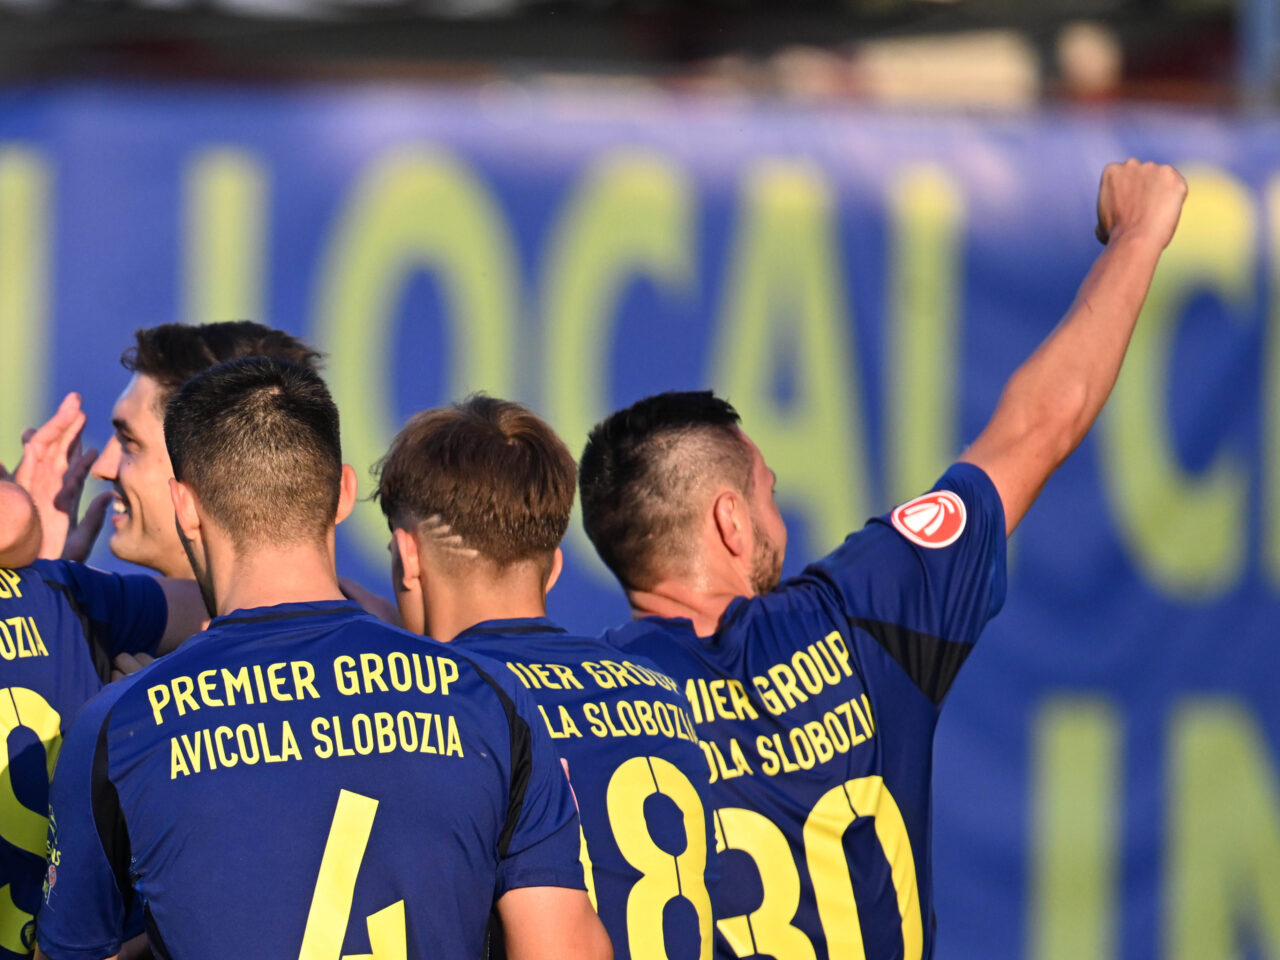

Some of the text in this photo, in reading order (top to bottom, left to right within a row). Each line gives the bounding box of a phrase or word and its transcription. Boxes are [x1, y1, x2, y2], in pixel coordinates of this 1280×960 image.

[147, 651, 460, 726] PREMIER GROUP
[752, 630, 853, 716] GROUP
[170, 710, 464, 780] AVICOLA SLOBOZIA
